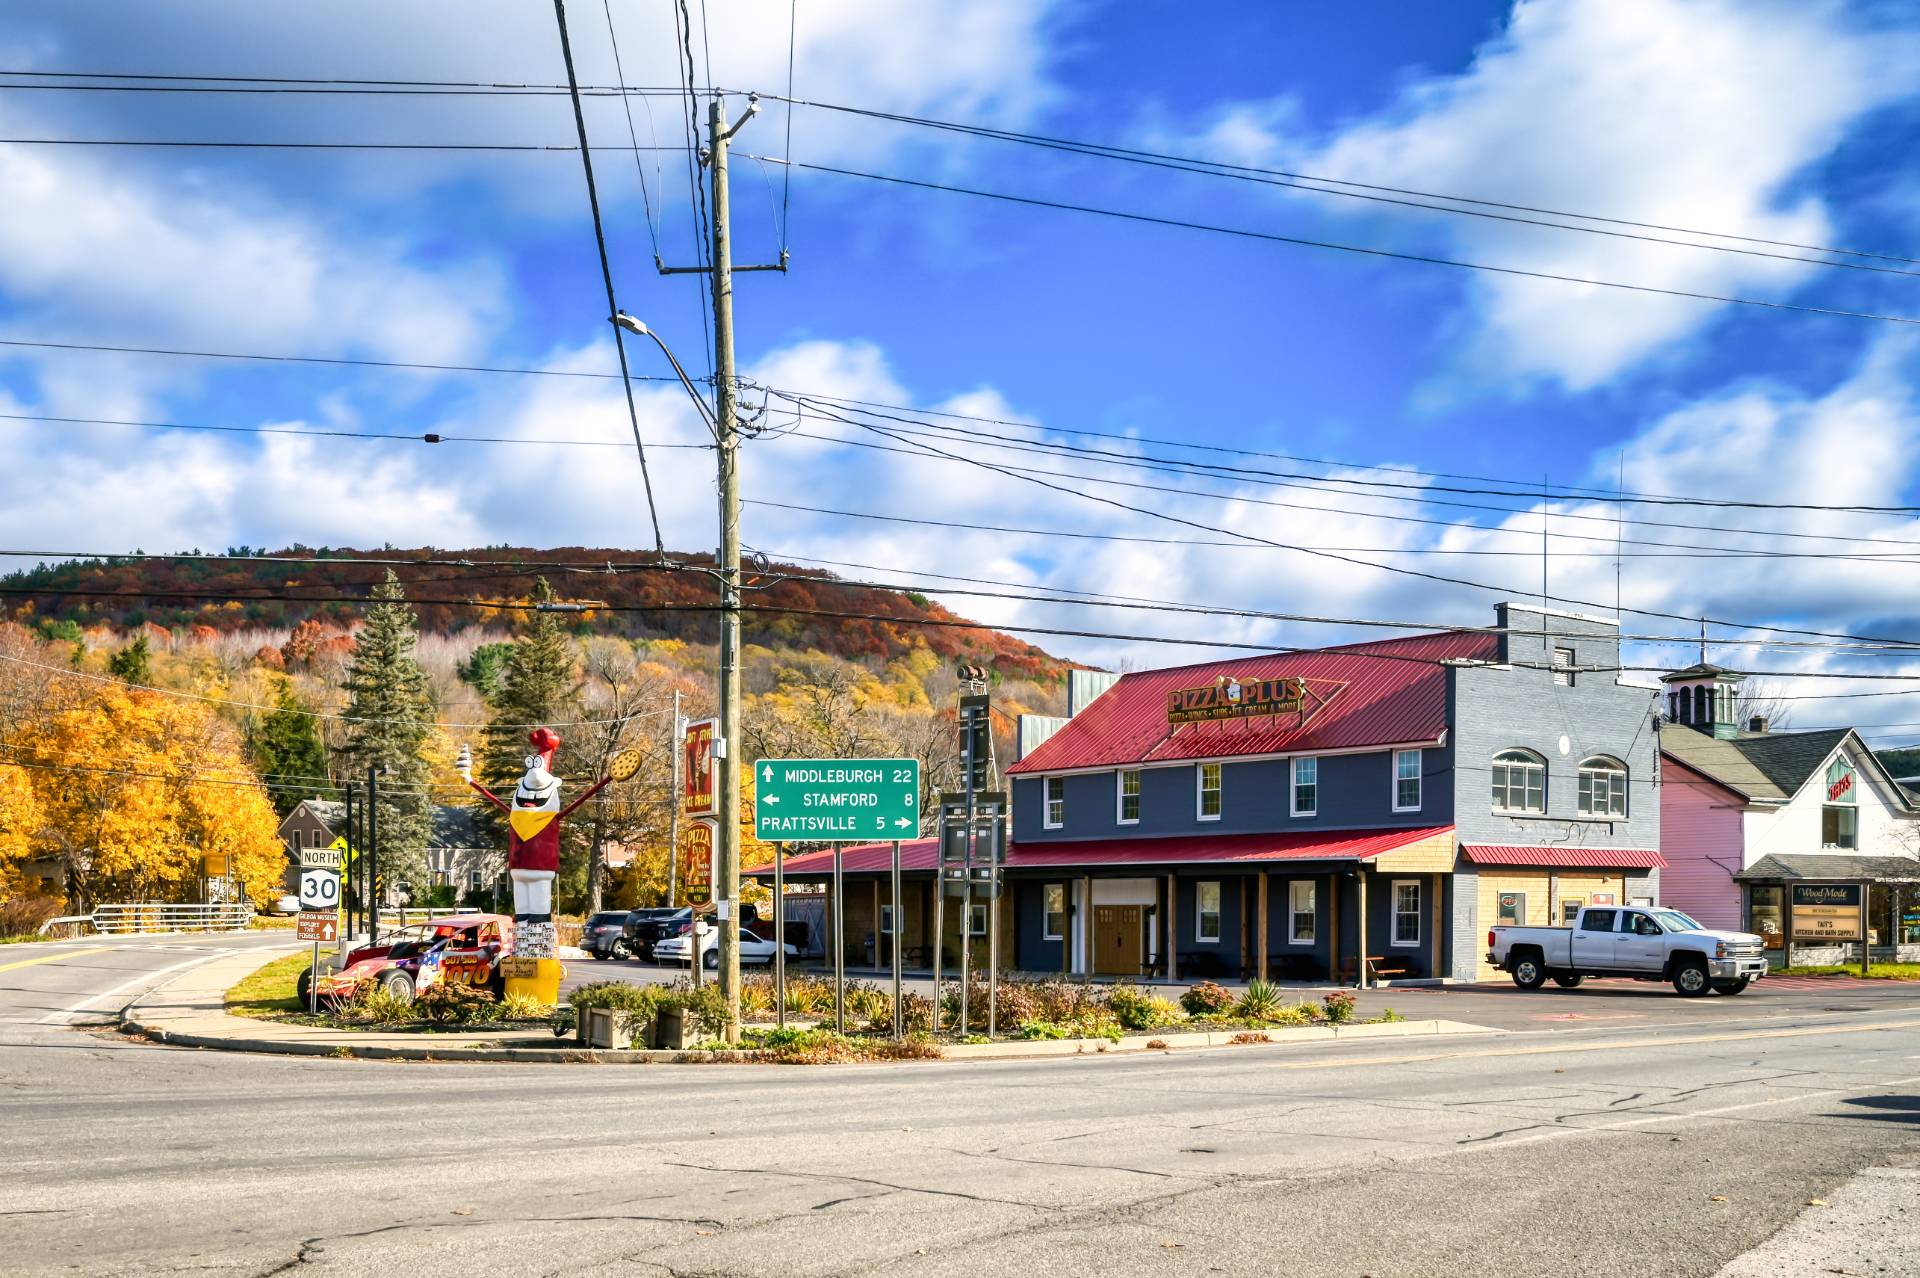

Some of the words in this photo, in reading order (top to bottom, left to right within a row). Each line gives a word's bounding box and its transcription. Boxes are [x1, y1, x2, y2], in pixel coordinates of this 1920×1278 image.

[1168, 687, 1231, 712] PIZZA
[1241, 679, 1301, 705] PLUS
[1169, 712, 1185, 721] PIZZA
[1187, 711, 1208, 720] WINGS
[1213, 708, 1228, 717] SUBS
[1232, 704, 1242, 716] ICE
[1244, 704, 1267, 715] CREAM
[1279, 702, 1297, 712] MORE
[785, 769, 883, 783] MIDDLEBURGH
[892, 769, 912, 783] 22
[694, 793, 712, 807] CREAM
[803, 793, 878, 807] STAMFORD
[904, 793, 913, 807] 8
[761, 816, 857, 830] PRATTSVILLE
[876, 816, 885, 830] 5
[687, 828, 711, 847] PIZZA
[304, 852, 339, 864] NORTH
[304, 877, 336, 900] 30
[1837, 929, 1855, 937] SUPPLY
